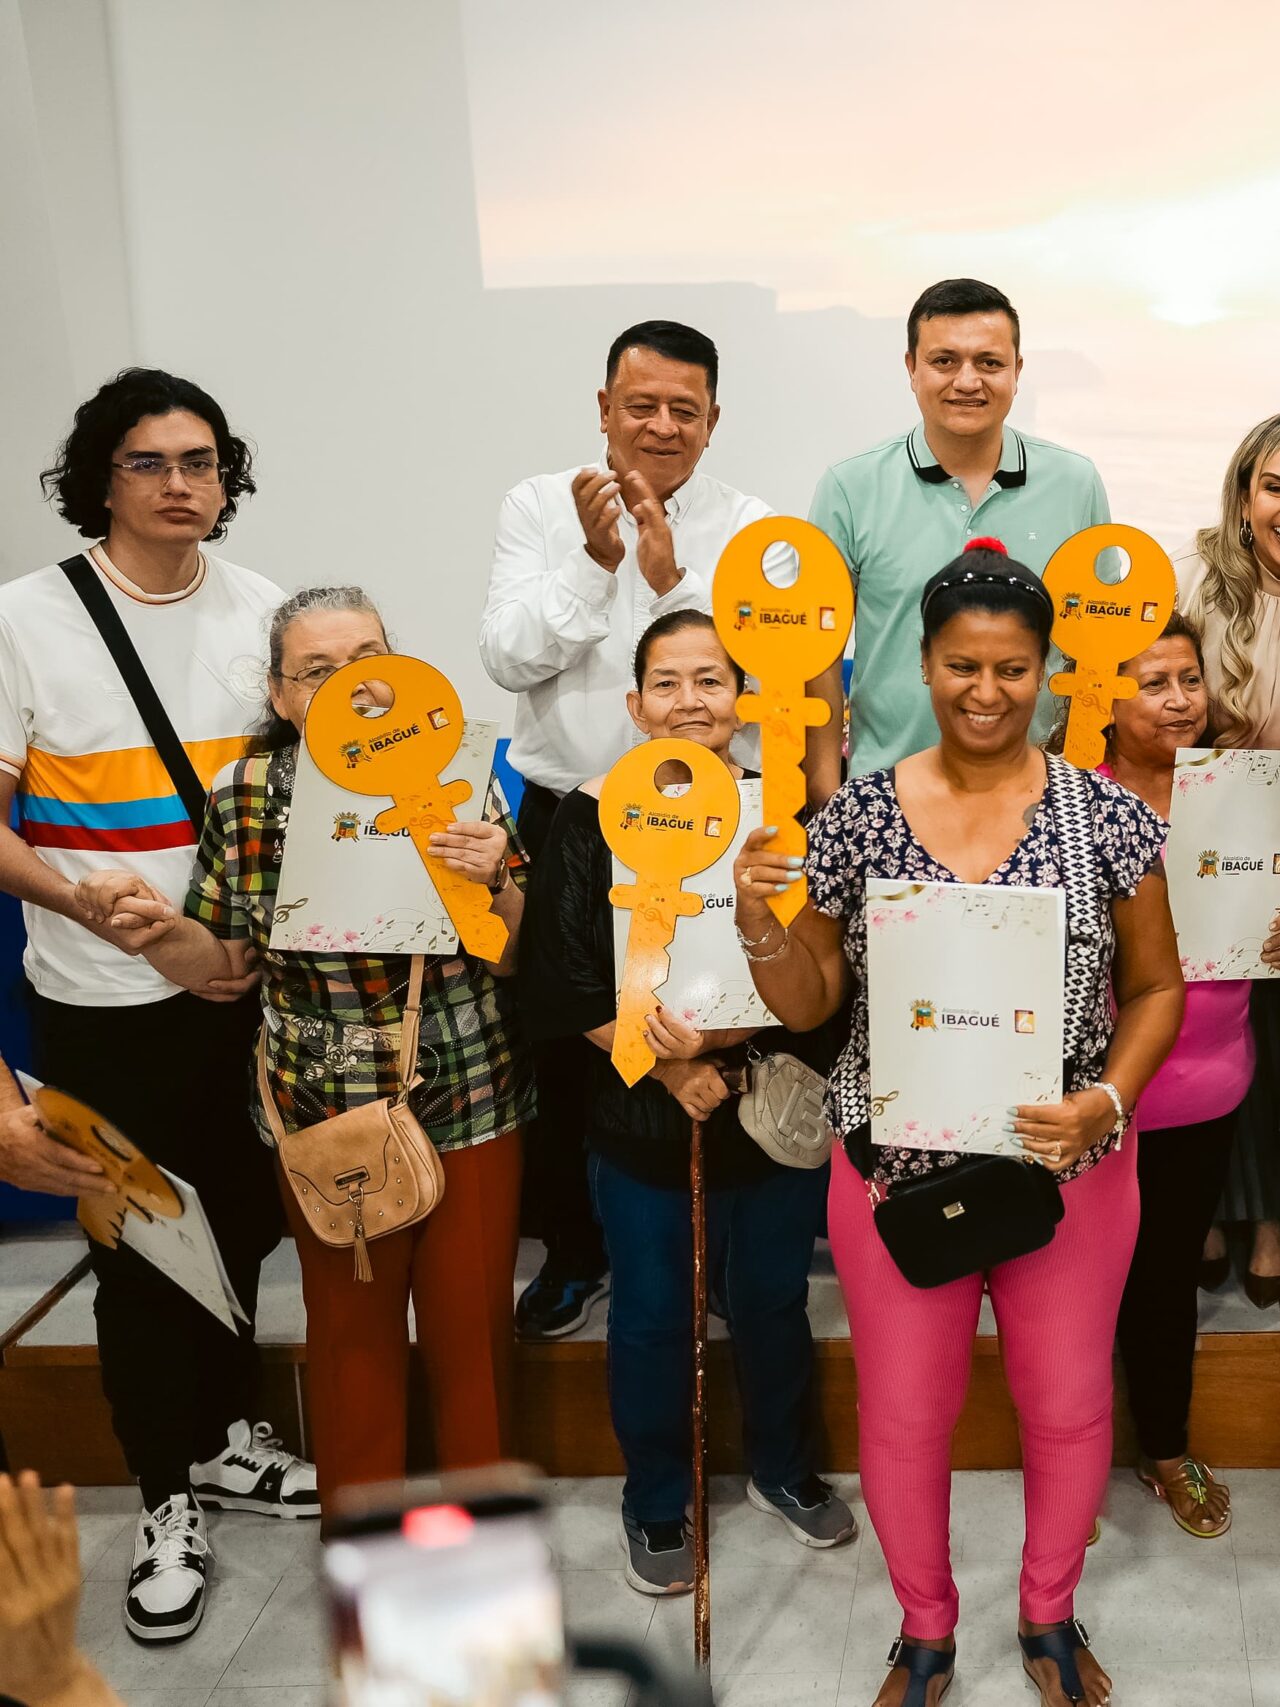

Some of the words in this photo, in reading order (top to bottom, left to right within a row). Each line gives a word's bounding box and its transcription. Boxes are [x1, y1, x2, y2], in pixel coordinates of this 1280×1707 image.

[1086, 605, 1131, 617] IBAGUÉ
[760, 612, 807, 625] IBAGUÉ
[370, 723, 421, 753] IBAGUÉ
[646, 816, 694, 831] IBAGUÉ
[1222, 858, 1264, 871] IBAGUÉ
[941, 1013, 1000, 1027] IBAGUÉ
